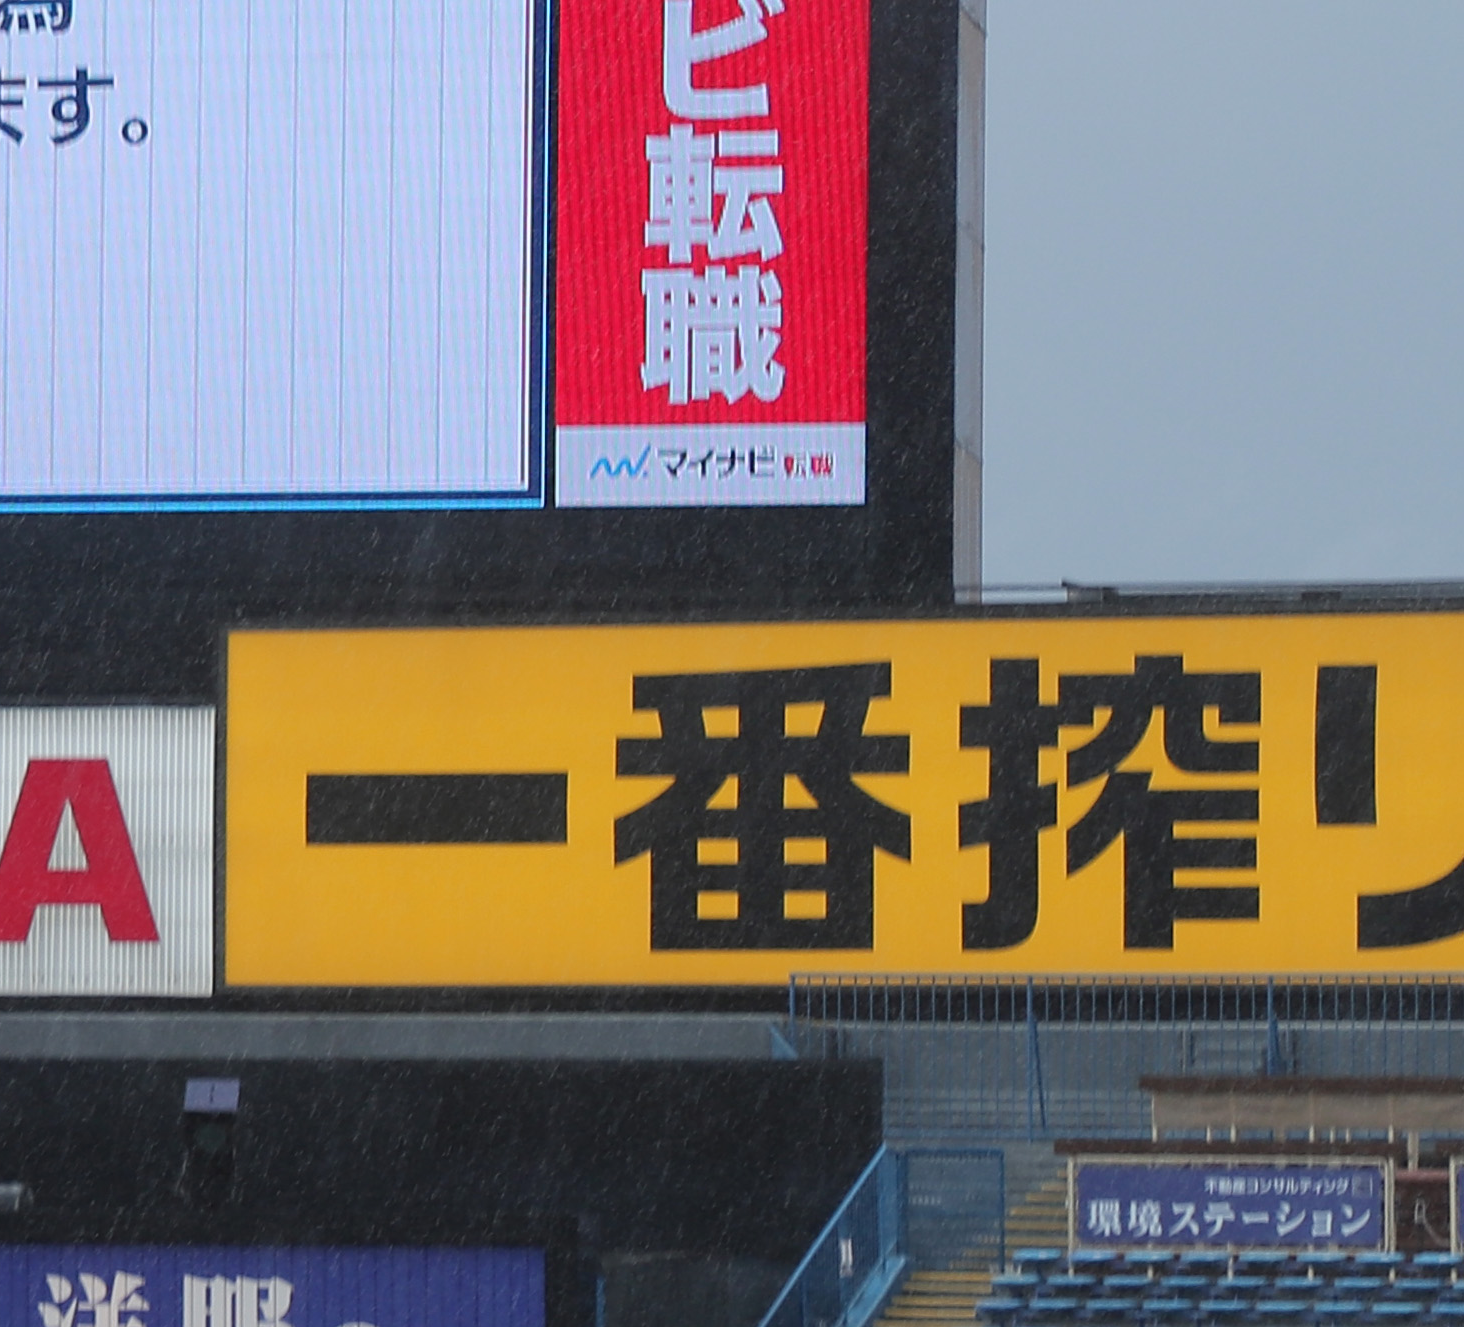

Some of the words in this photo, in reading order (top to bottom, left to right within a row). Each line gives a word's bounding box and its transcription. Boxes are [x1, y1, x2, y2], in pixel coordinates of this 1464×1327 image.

[1087, 1198, 1372, 1239] 環境ステーション
